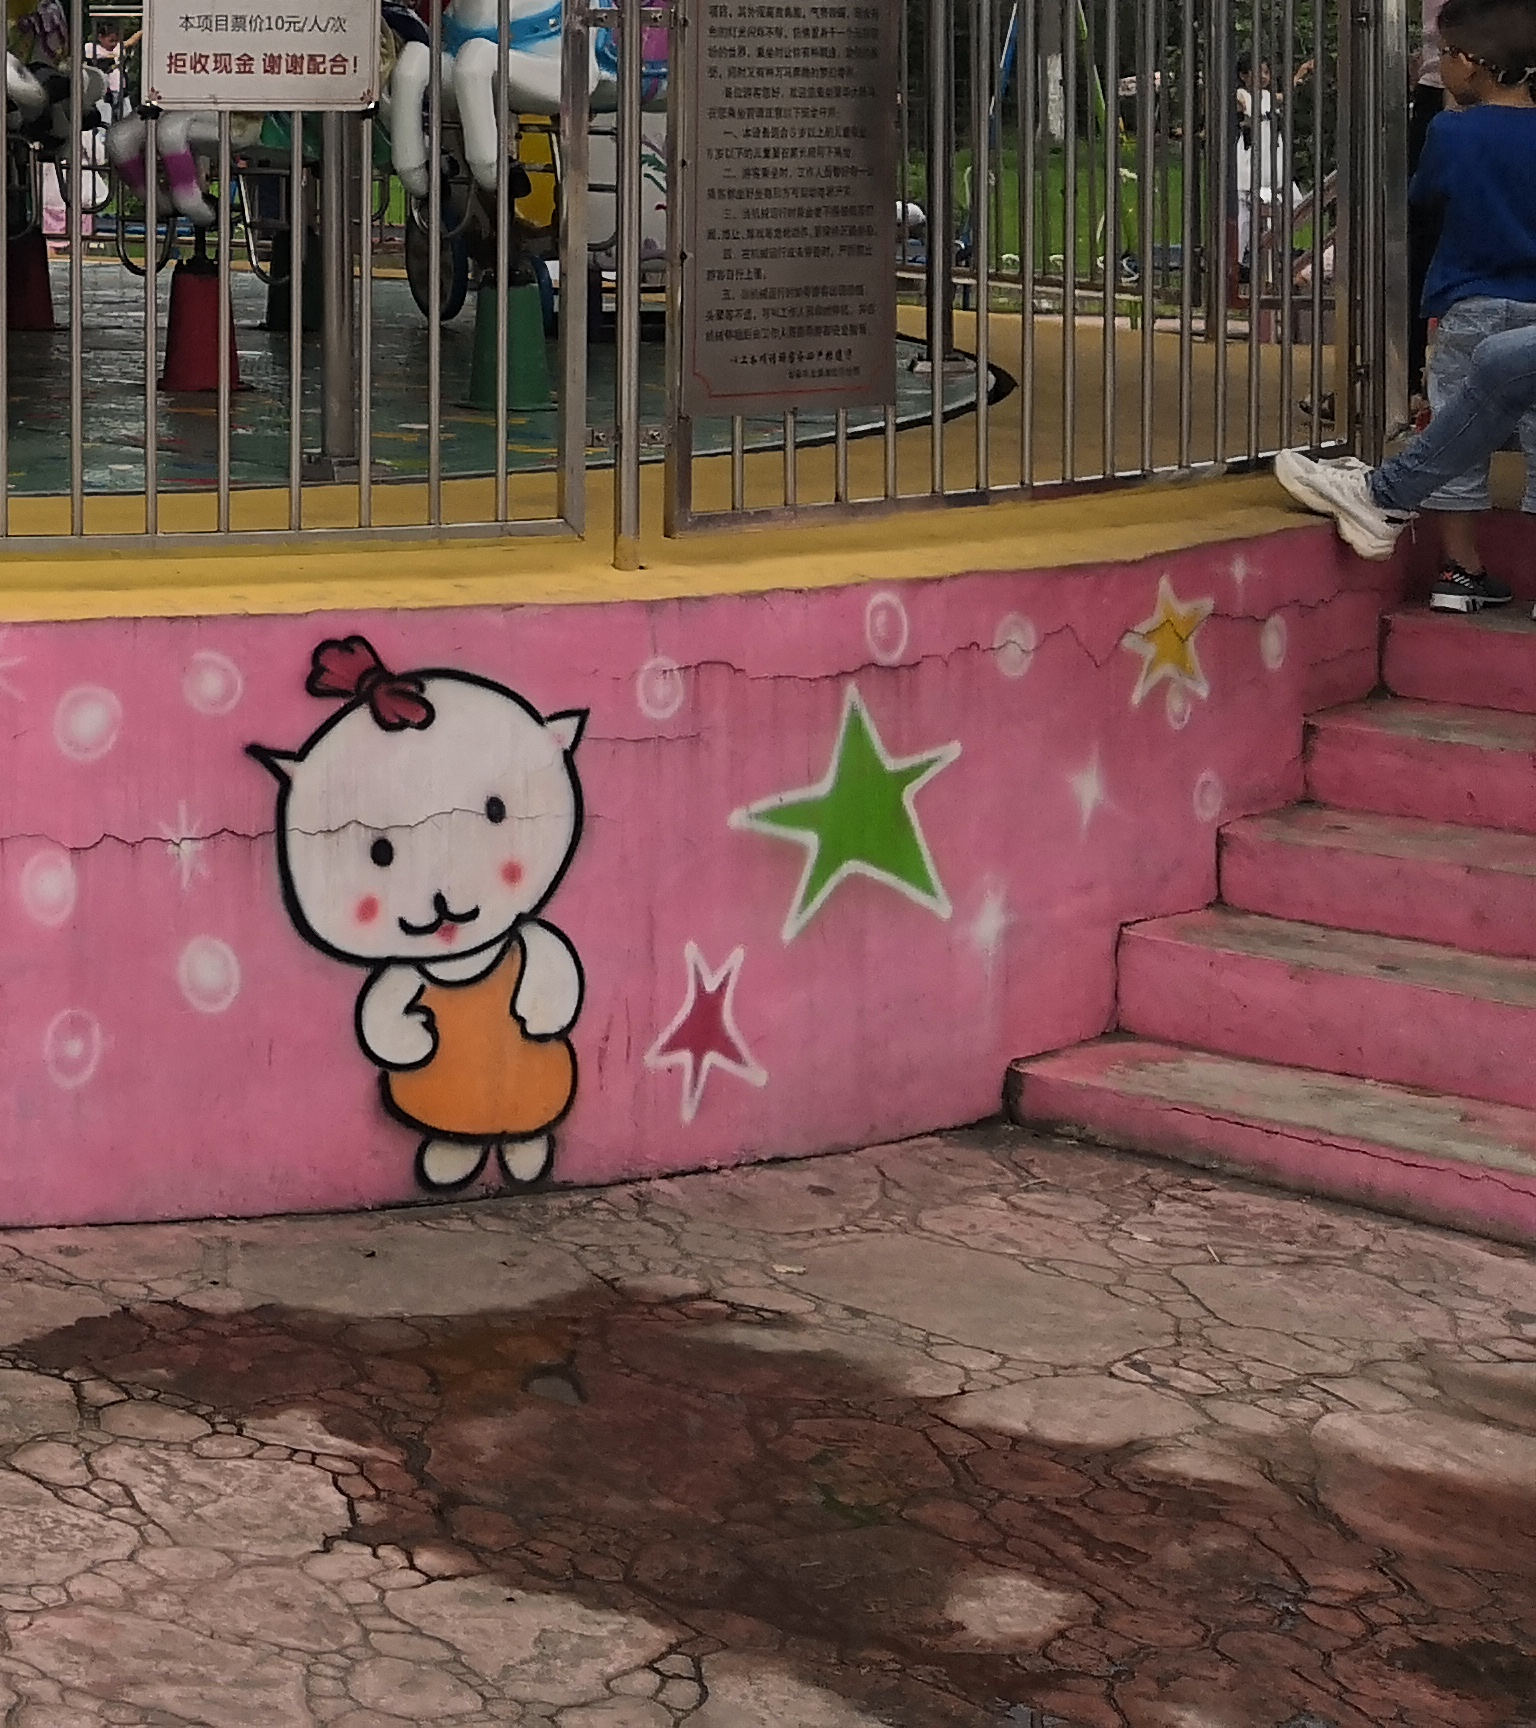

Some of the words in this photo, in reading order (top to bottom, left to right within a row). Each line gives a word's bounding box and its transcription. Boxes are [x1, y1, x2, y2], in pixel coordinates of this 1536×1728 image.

[178, 15, 346, 33] 本项目票价10元/人/次
[166, 52, 255, 75] 拒收现金
